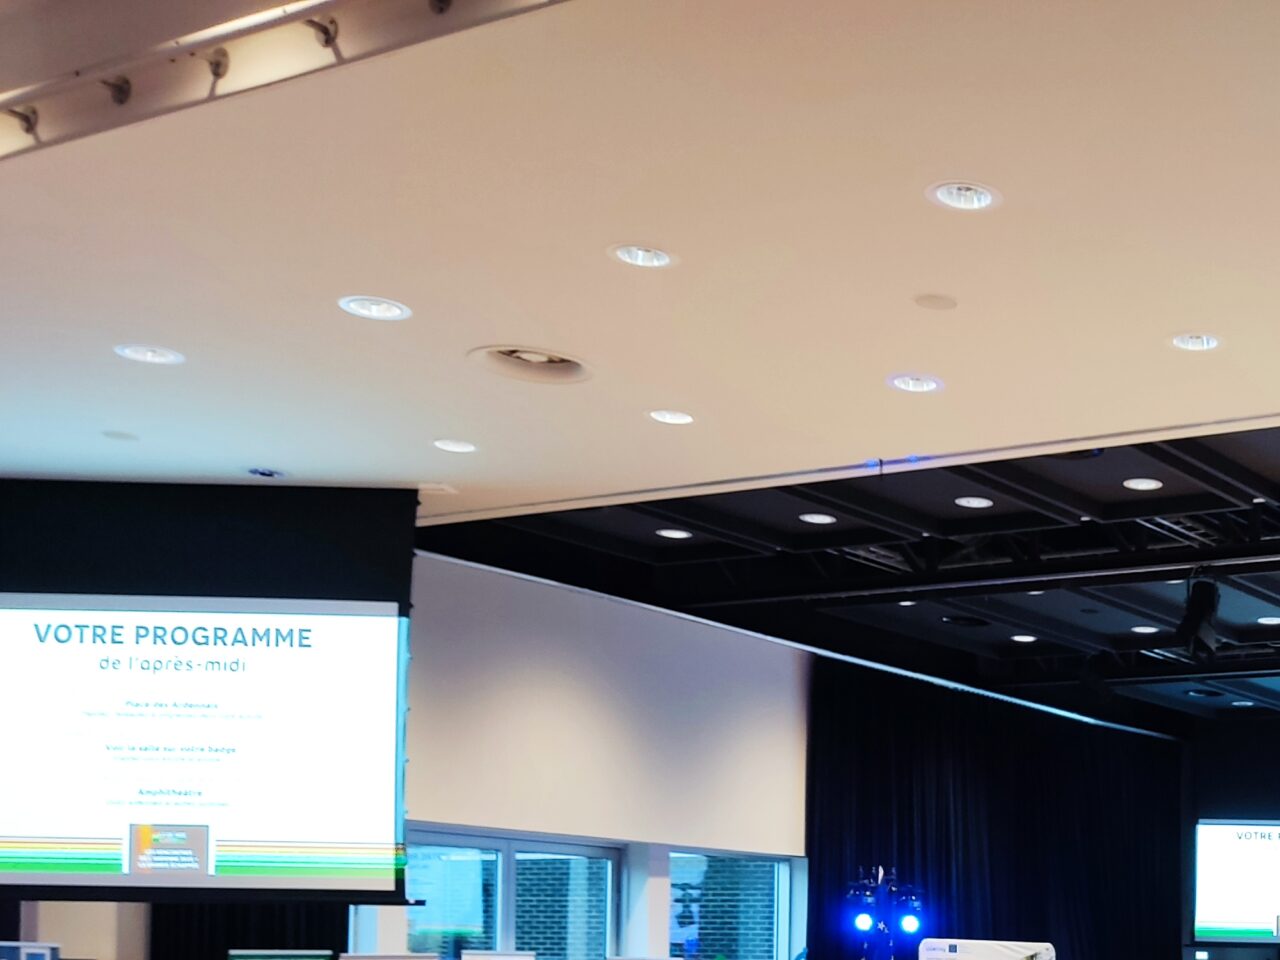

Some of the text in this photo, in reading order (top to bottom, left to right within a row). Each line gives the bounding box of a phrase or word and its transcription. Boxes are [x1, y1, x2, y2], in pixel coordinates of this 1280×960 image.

[34, 623, 312, 648] VOTRE PROGRAMME
[99, 655, 247, 674] de l'après-midi
[1236, 831, 1273, 841] VOTRE
